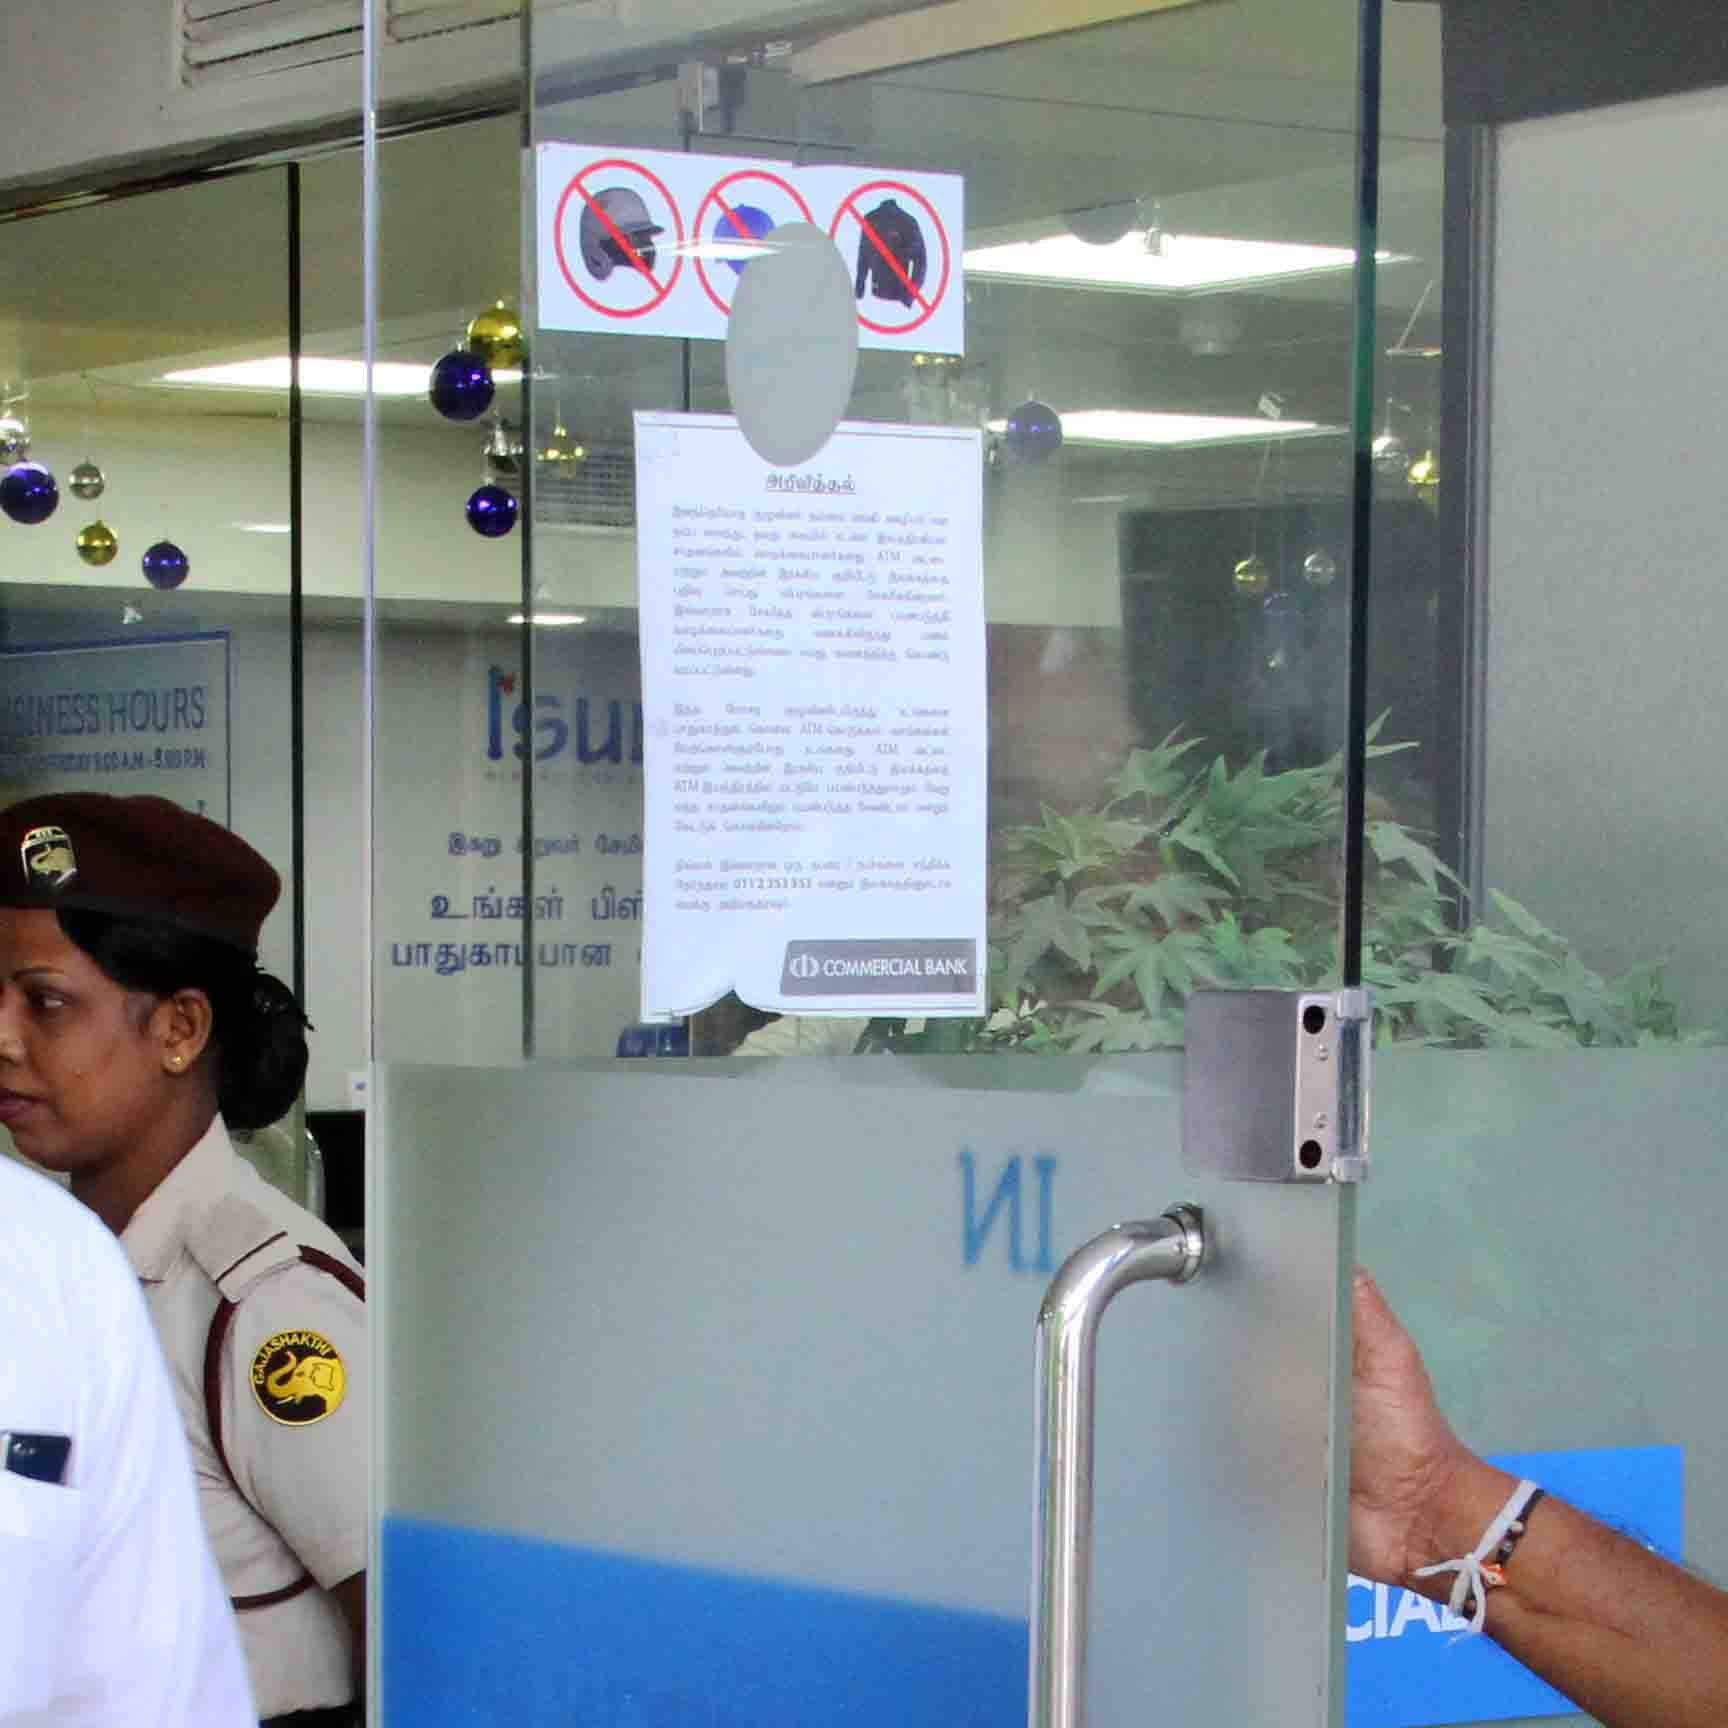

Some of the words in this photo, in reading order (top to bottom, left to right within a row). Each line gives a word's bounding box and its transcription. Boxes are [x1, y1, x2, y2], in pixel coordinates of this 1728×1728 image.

[110, 685, 206, 733] HOURS
[822, 958, 922, 978] COMMERCIAL
[924, 958, 968, 976] BANK
